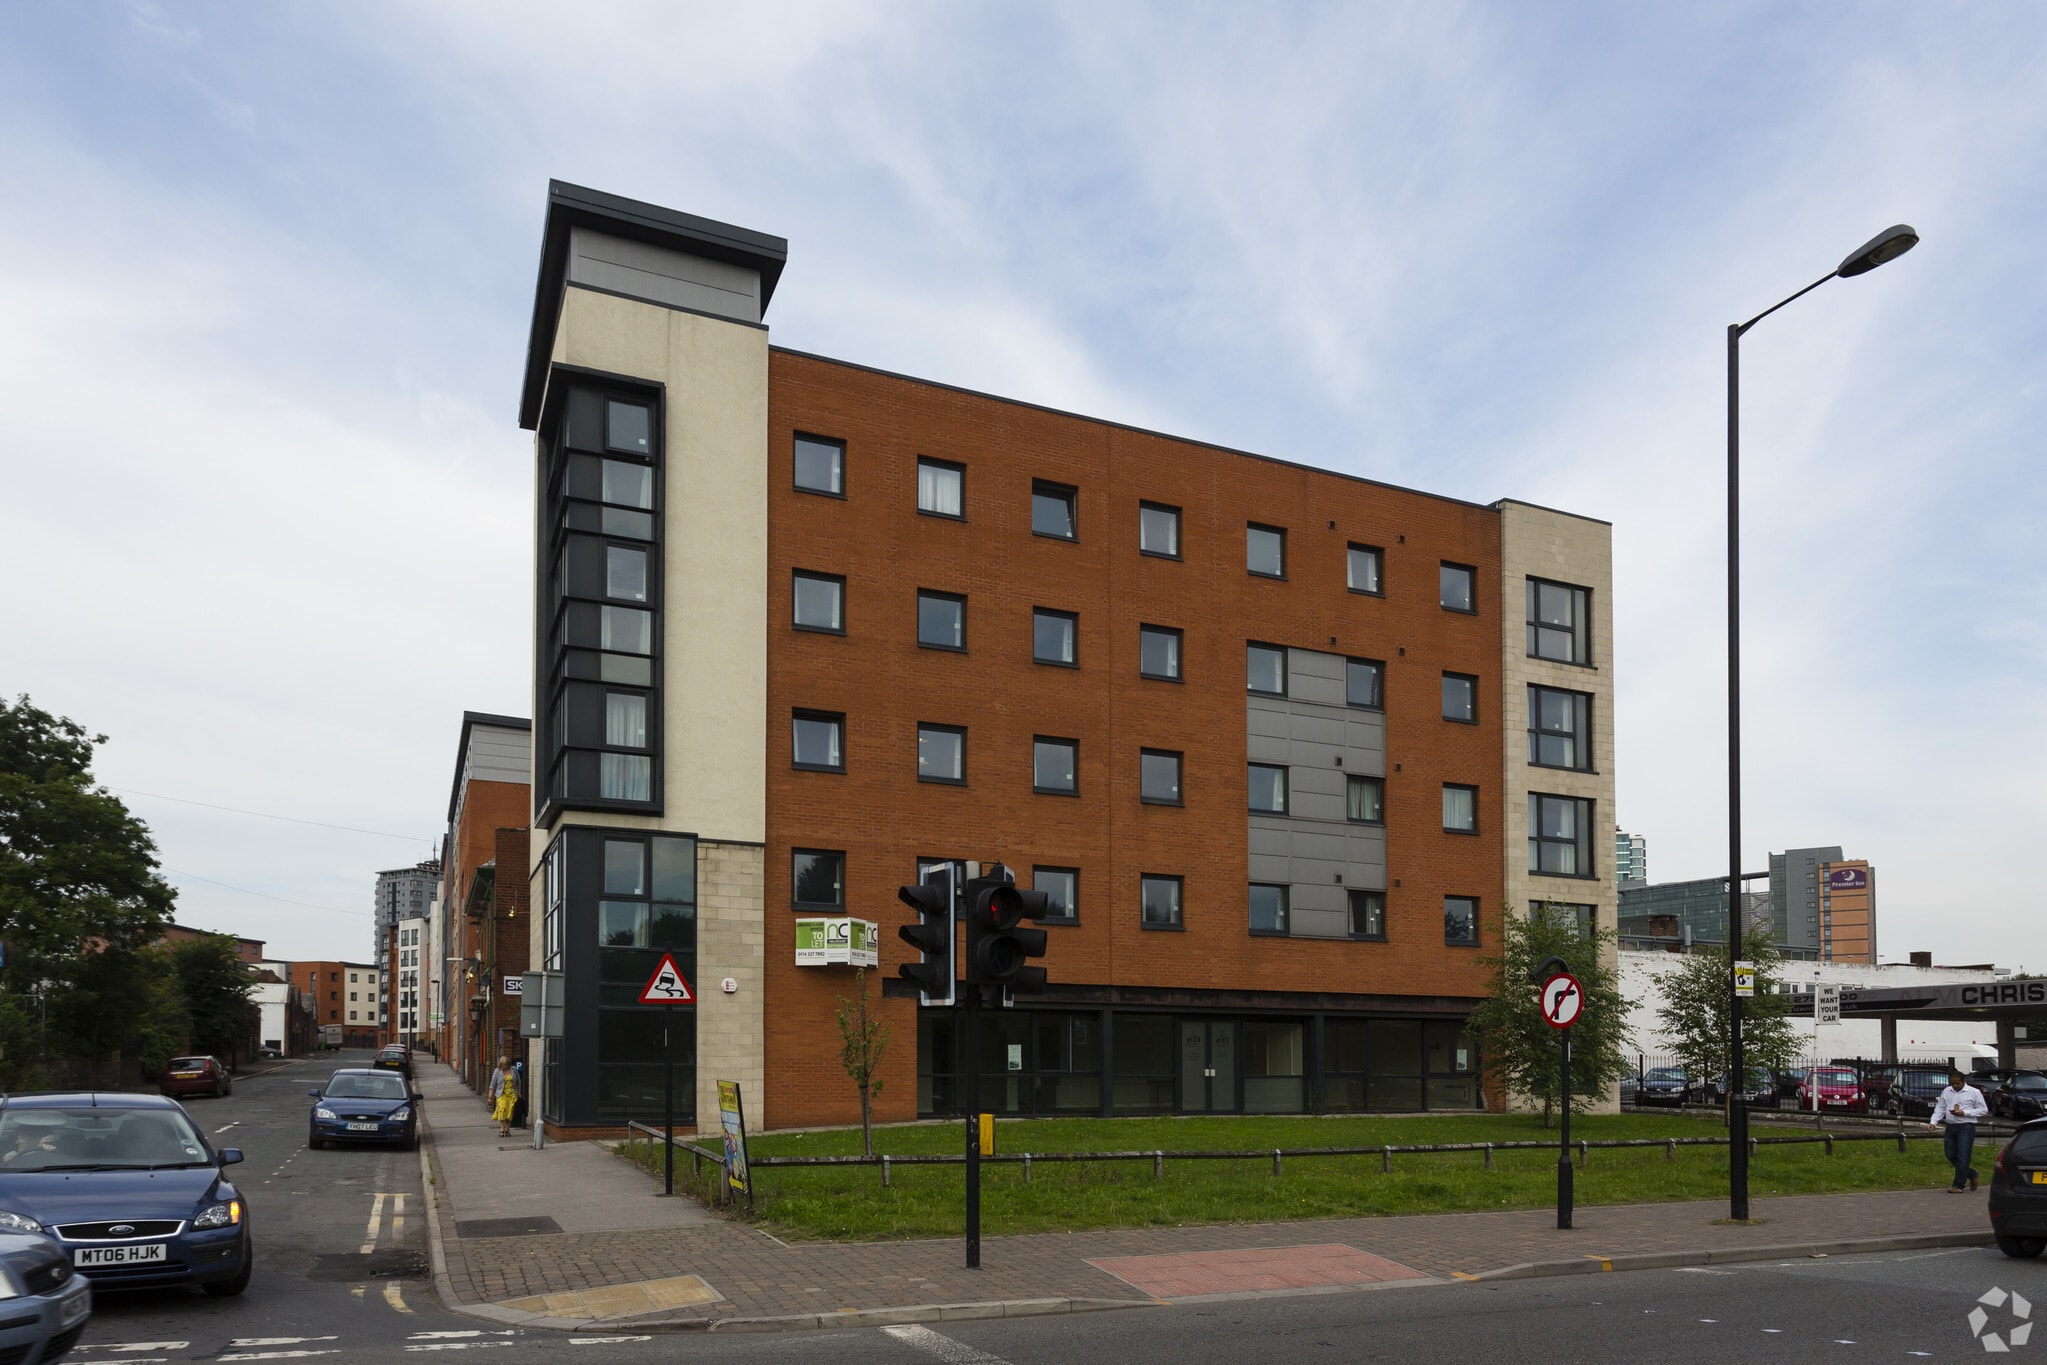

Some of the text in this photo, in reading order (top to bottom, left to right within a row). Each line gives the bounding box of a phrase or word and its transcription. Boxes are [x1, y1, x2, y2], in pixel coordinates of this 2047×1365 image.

[811, 940, 824, 948] LET
[507, 981, 522, 990] SK
[1962, 983, 2045, 1004] CHRIS
[516, 1062, 522, 1070] P
[82, 1246, 160, 1263] MT06 HJK
